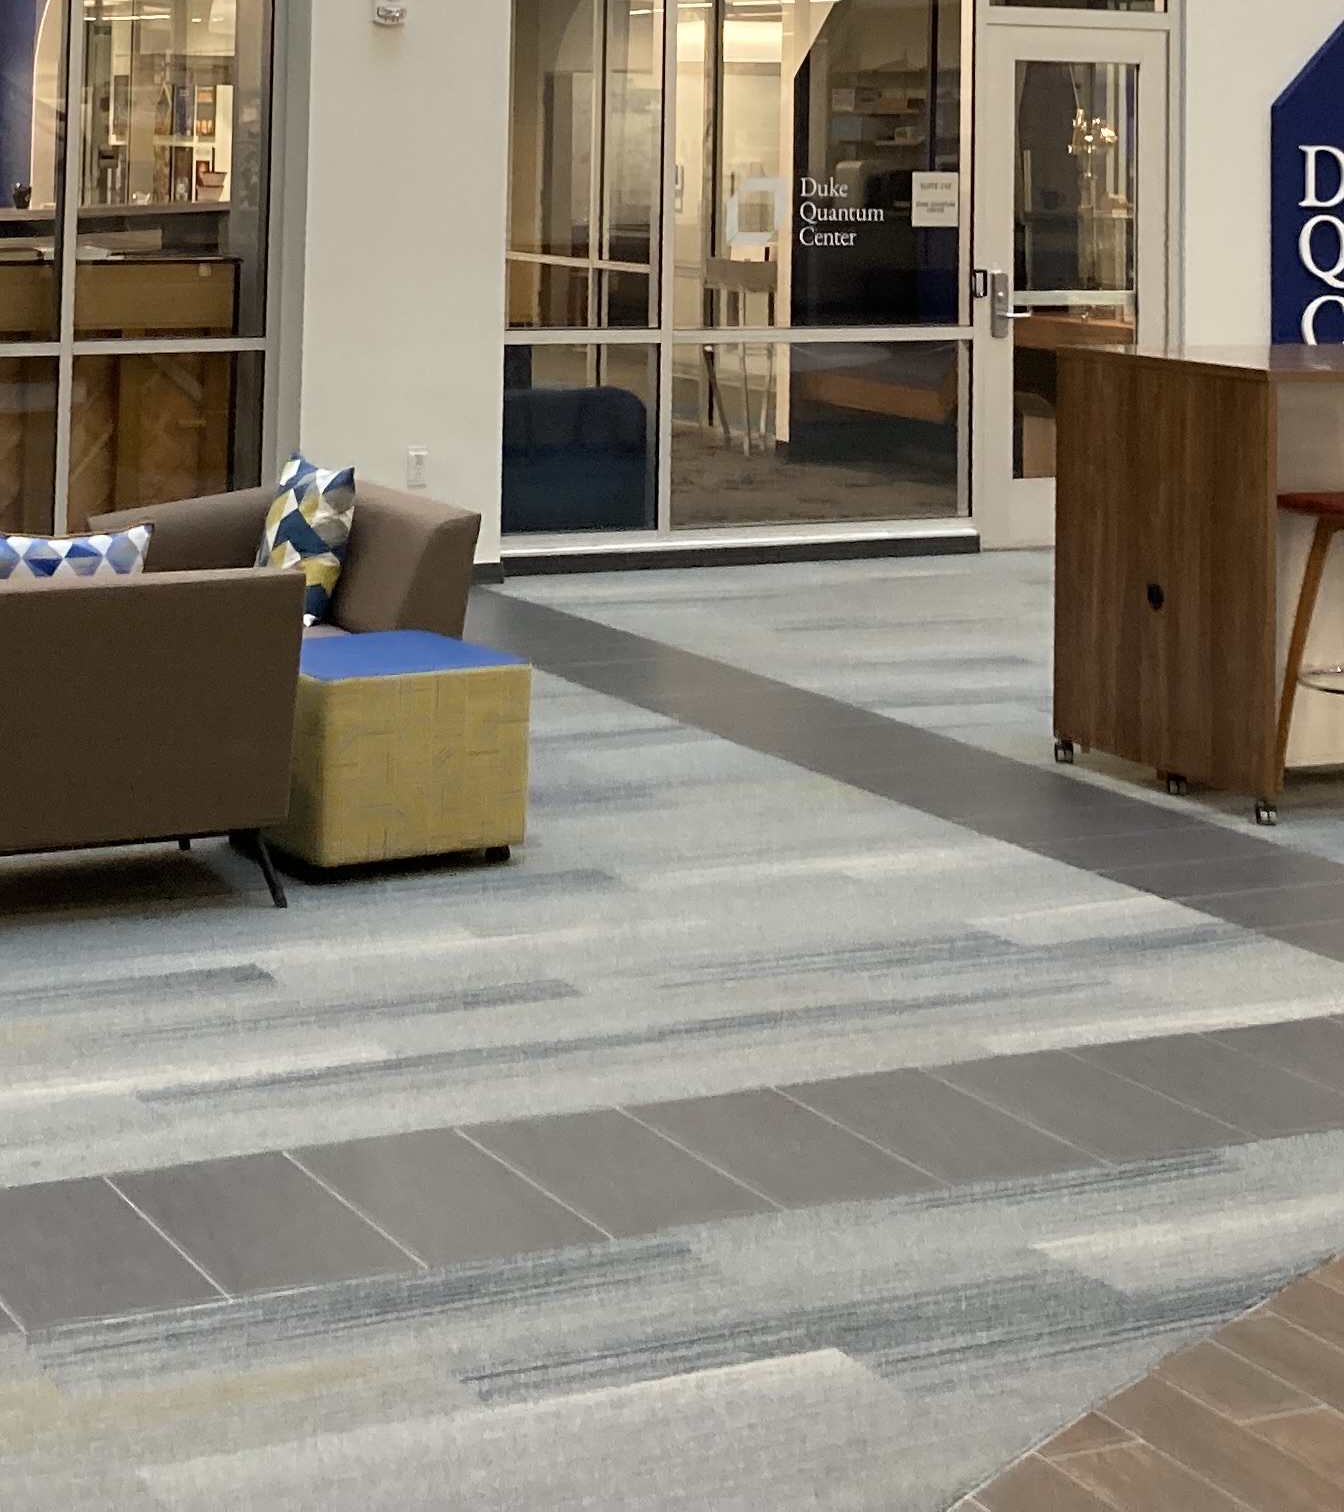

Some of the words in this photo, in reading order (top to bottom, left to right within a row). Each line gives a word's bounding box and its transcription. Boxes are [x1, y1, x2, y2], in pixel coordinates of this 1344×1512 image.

[799, 176, 848, 197] Duke
[799, 202, 885, 224] Quantum
[799, 226, 856, 246] Center
